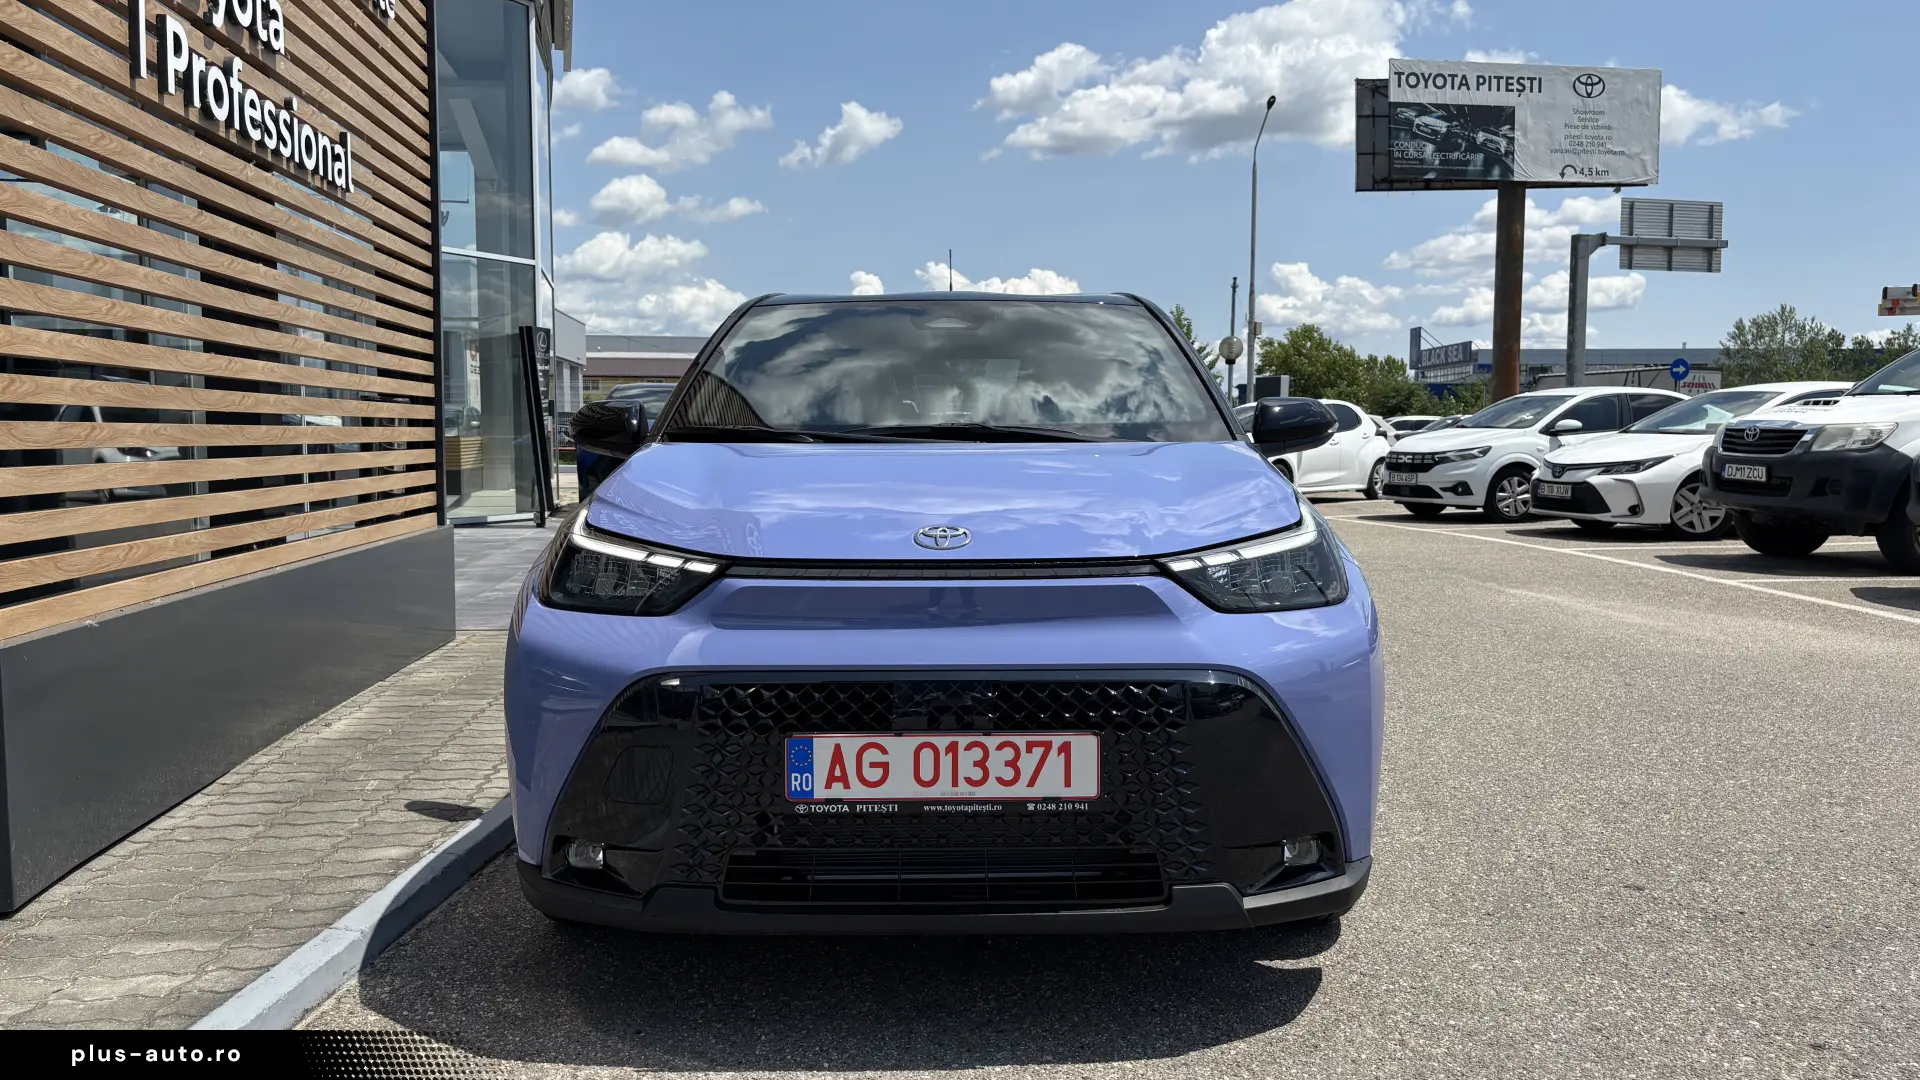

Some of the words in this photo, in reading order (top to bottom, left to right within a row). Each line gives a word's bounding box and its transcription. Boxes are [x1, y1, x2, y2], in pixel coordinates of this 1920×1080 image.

[1394, 71, 1471, 91] TOYOTA
[1476, 74, 1542, 97] PITEȘTI
[165, 14, 355, 193] Professional
[1572, 108, 1605, 116] Showroom
[1579, 167, 1593, 177] 4,5
[1595, 167, 1609, 176] km
[1421, 347, 1446, 367] BLACK
[1447, 344, 1463, 363] SEA
[1747, 467, 1764, 479] ZCU
[823, 740, 890, 790] AG
[912, 740, 1072, 788] 013371
[791, 772, 812, 792] RO
[809, 804, 849, 813] TOYOTA
[1037, 803, 1056, 811] 0248
[1058, 803, 1073, 811] 210
[1074, 803, 1089, 811] 941
